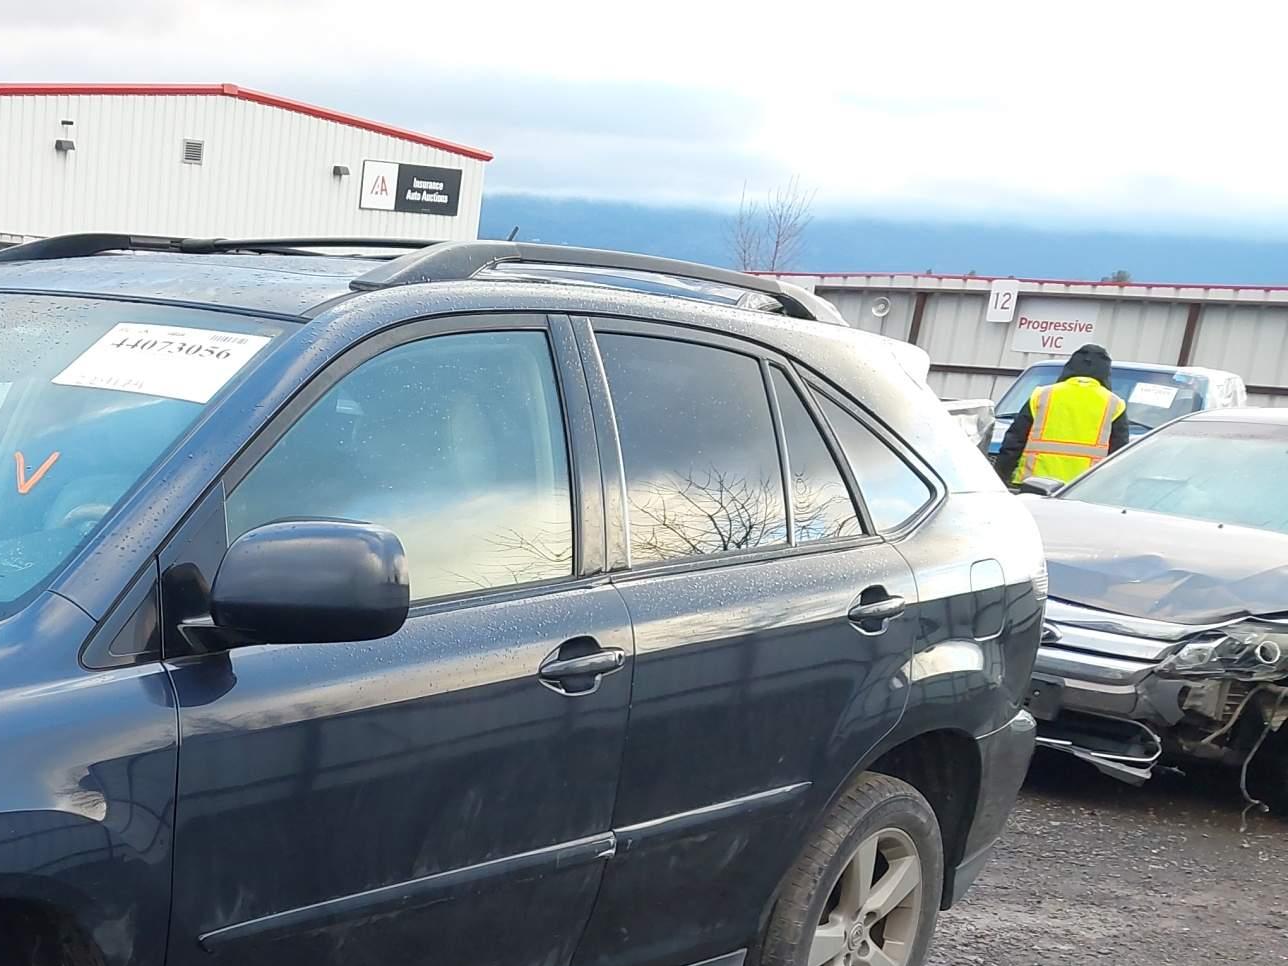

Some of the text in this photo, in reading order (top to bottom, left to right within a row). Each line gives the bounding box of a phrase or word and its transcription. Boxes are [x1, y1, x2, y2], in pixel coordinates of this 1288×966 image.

[405, 189, 421, 201] Auto
[992, 292, 1012, 310] 12
[1018, 317, 1094, 333] Progressive
[111, 336, 232, 360] 44073056
[1041, 336, 1063, 348] VIC
